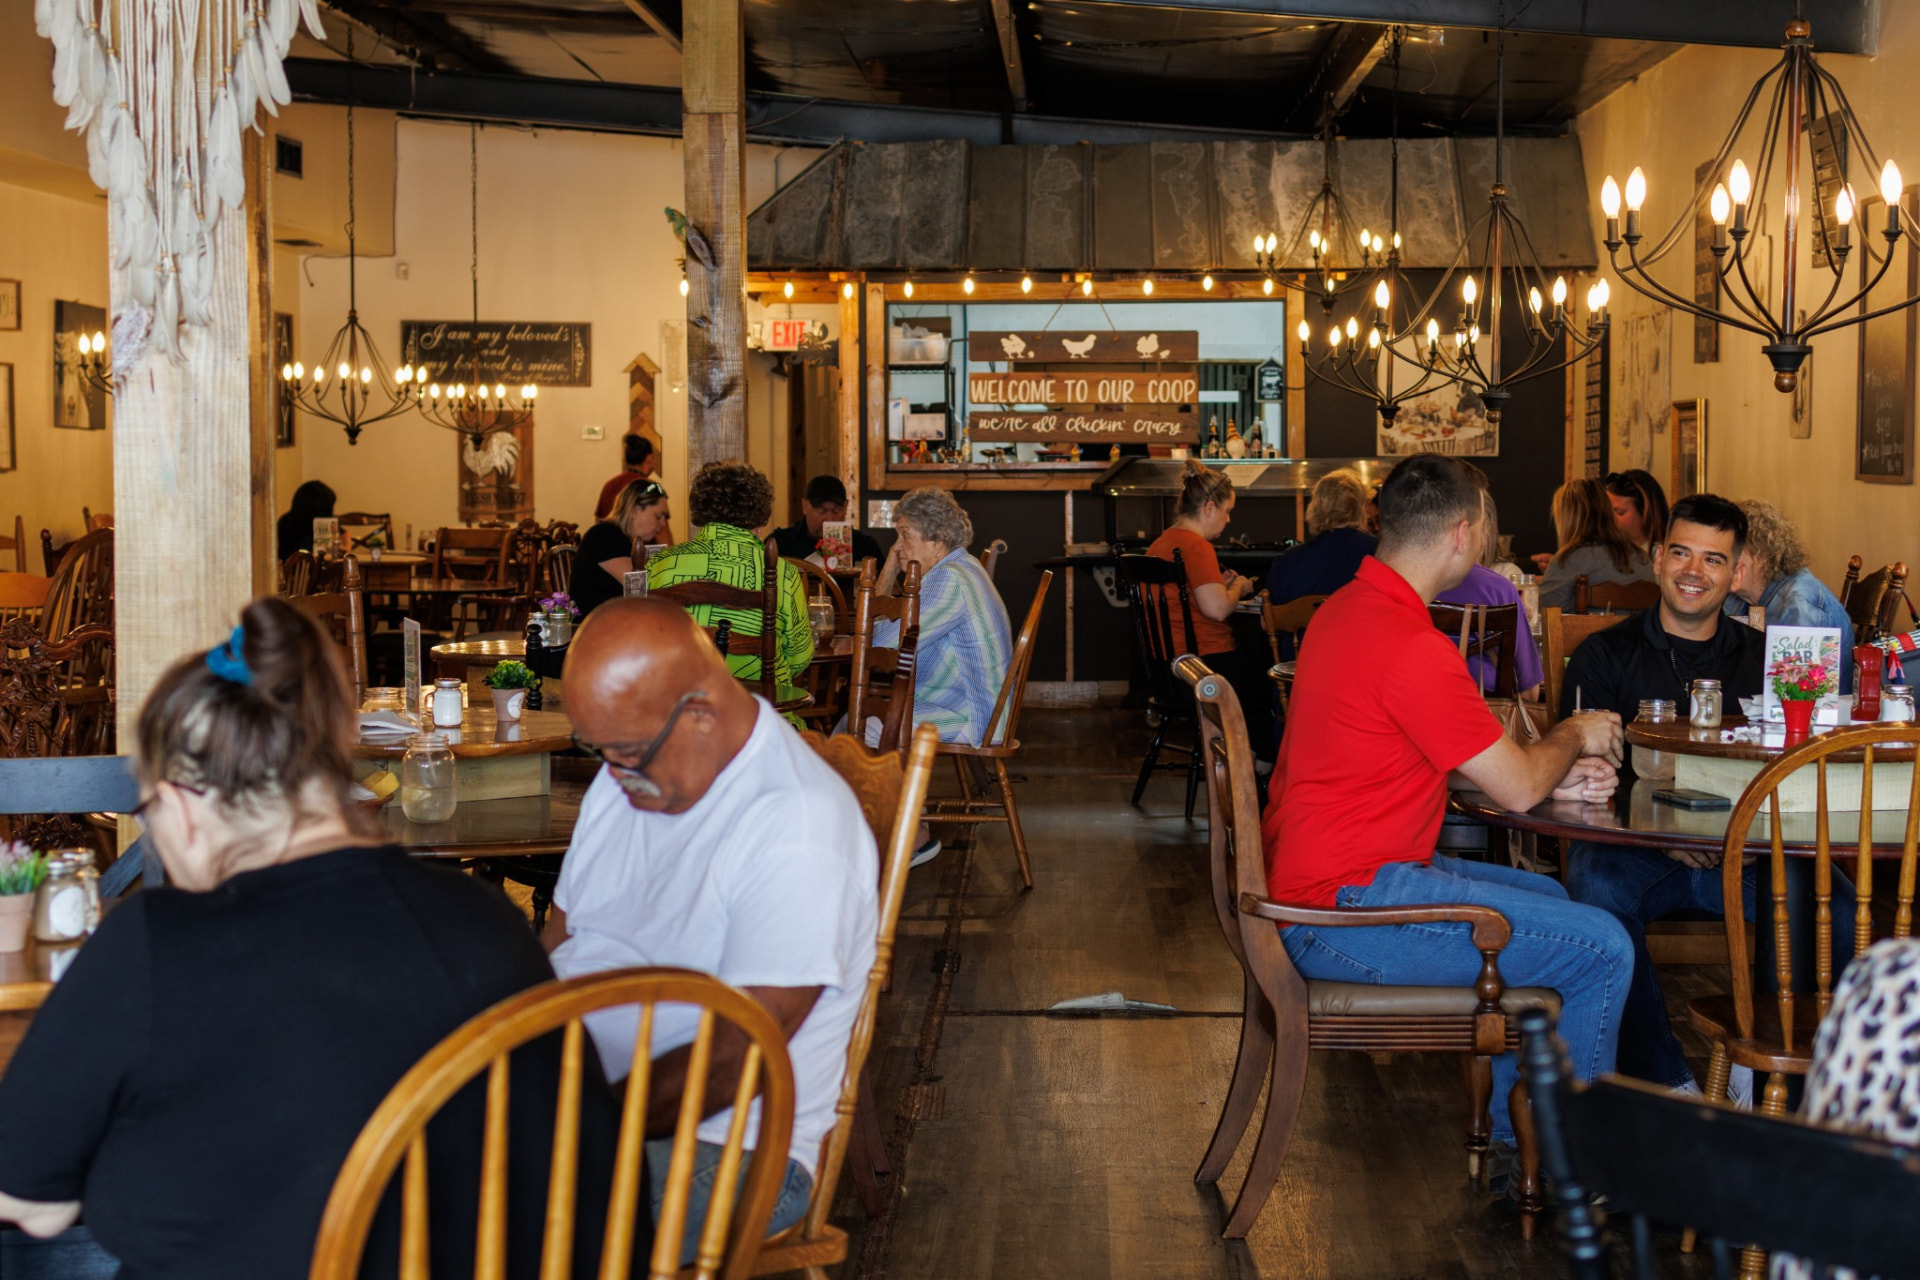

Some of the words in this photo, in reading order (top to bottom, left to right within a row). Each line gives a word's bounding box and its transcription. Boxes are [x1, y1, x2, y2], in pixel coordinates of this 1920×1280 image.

[447, 330, 472, 340] am
[477, 330, 501, 346] my
[506, 324, 570, 343] beloved's
[773, 321, 805, 347] EXIT
[511, 358, 523, 371] is
[971, 380, 1056, 403] WELCOME
[1064, 380, 1089, 402] TO
[1098, 380, 1135, 403] OUR
[1147, 380, 1196, 403] COOP
[979, 416, 1029, 432] we're
[1032, 416, 1057, 432] all
[1133, 418, 1182, 436] crazy
[1776, 636, 1813, 654] Salad
